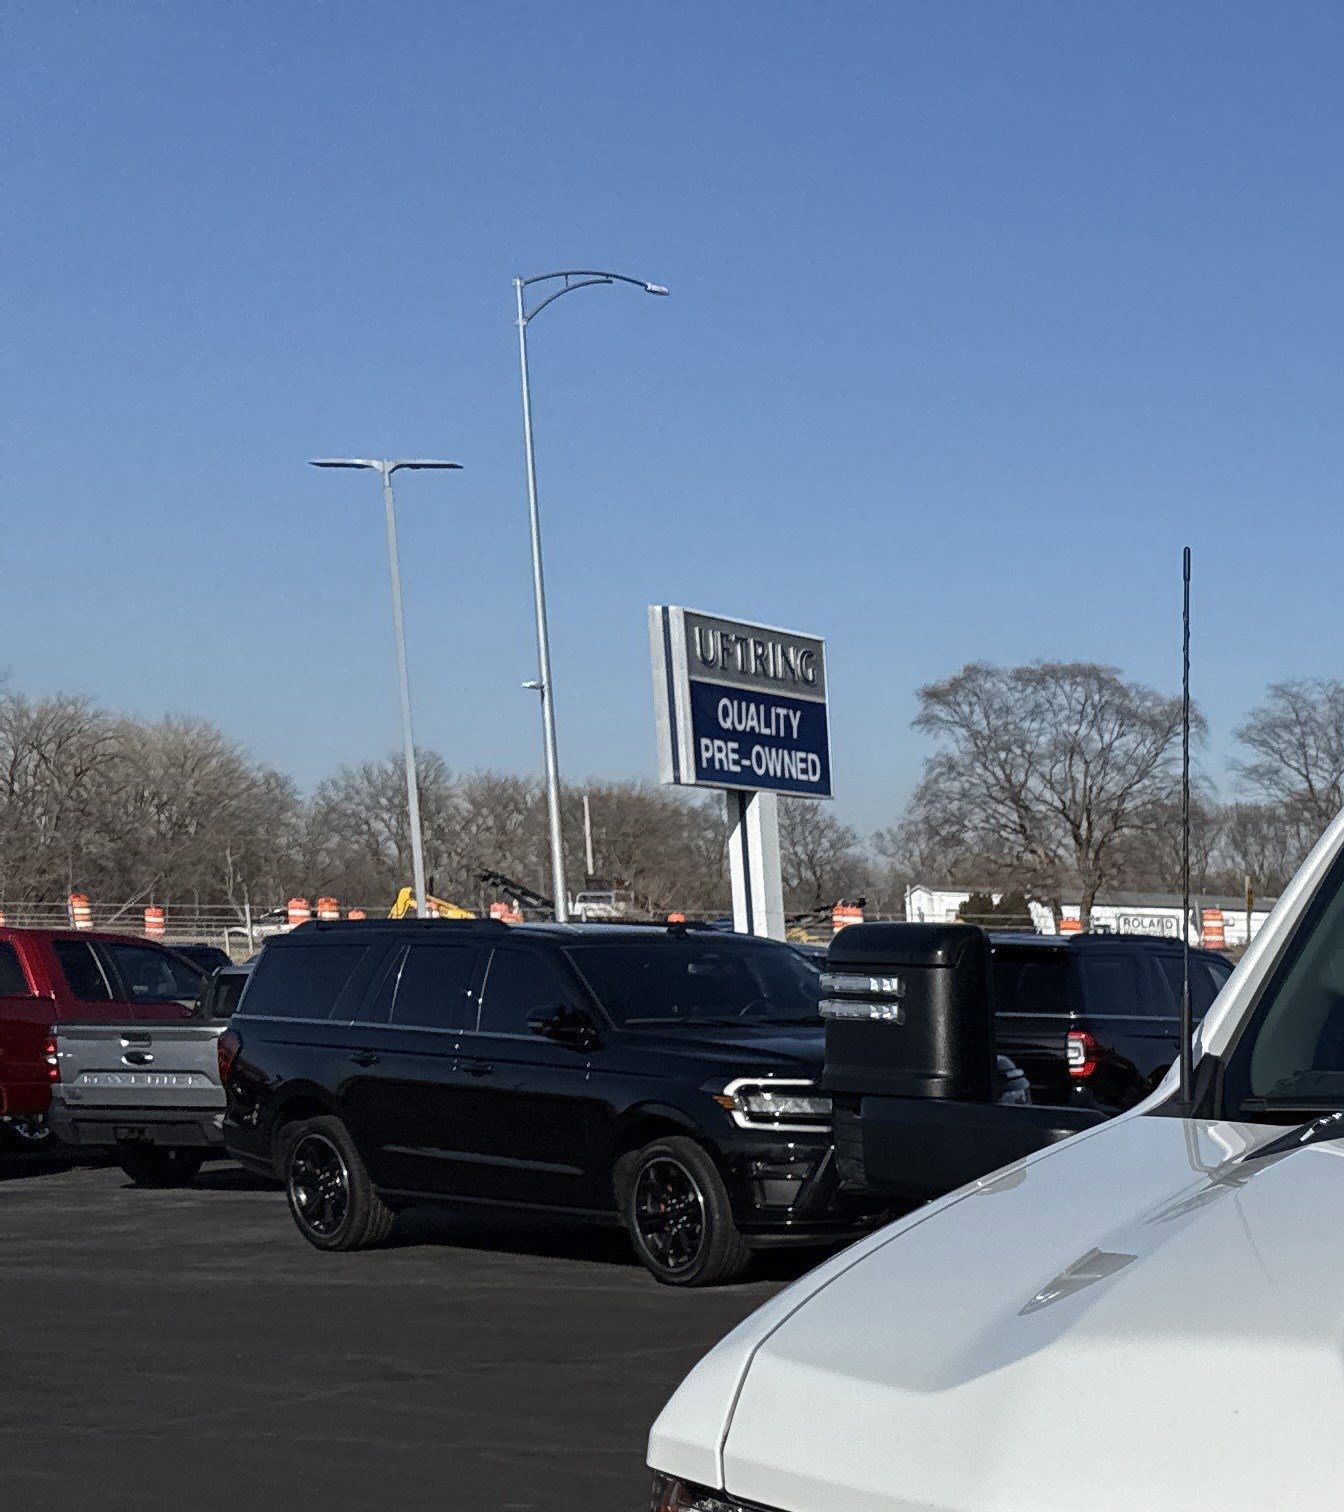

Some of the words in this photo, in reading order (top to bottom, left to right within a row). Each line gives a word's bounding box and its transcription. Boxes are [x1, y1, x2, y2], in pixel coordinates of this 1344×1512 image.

[695, 627, 816, 684] UFTRING
[717, 698, 801, 739] QUALITY
[700, 737, 821, 782] PRE-OWNED
